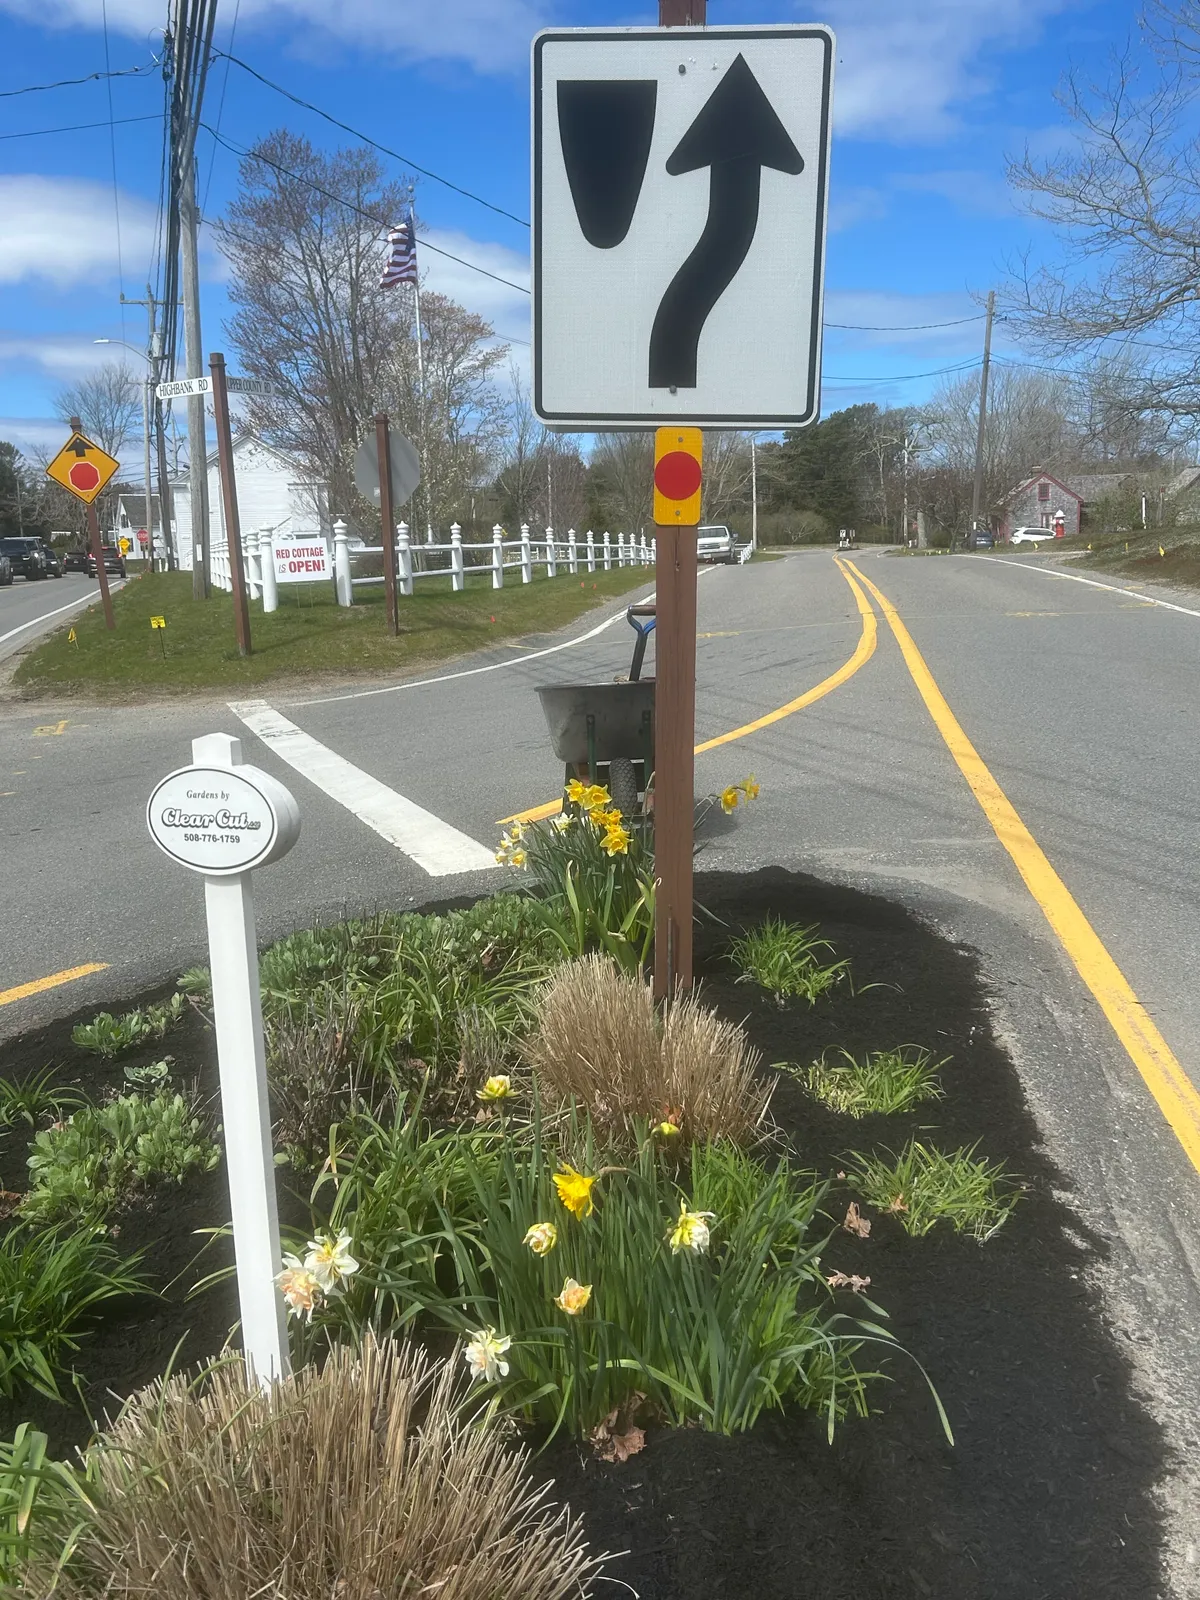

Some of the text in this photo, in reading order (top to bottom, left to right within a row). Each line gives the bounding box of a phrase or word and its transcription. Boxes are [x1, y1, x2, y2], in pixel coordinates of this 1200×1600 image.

[159, 379, 209, 396] HIGHBANK RD
[243, 379, 262, 393] COUNTY
[264, 381, 272, 393] RD
[276, 547, 324, 559] RED COTTAGE
[288, 560, 325, 573] OPEN!
[186, 790, 230, 801] Gardens by
[161, 807, 215, 829] Clear
[183, 833, 241, 843] 508-776-1759
